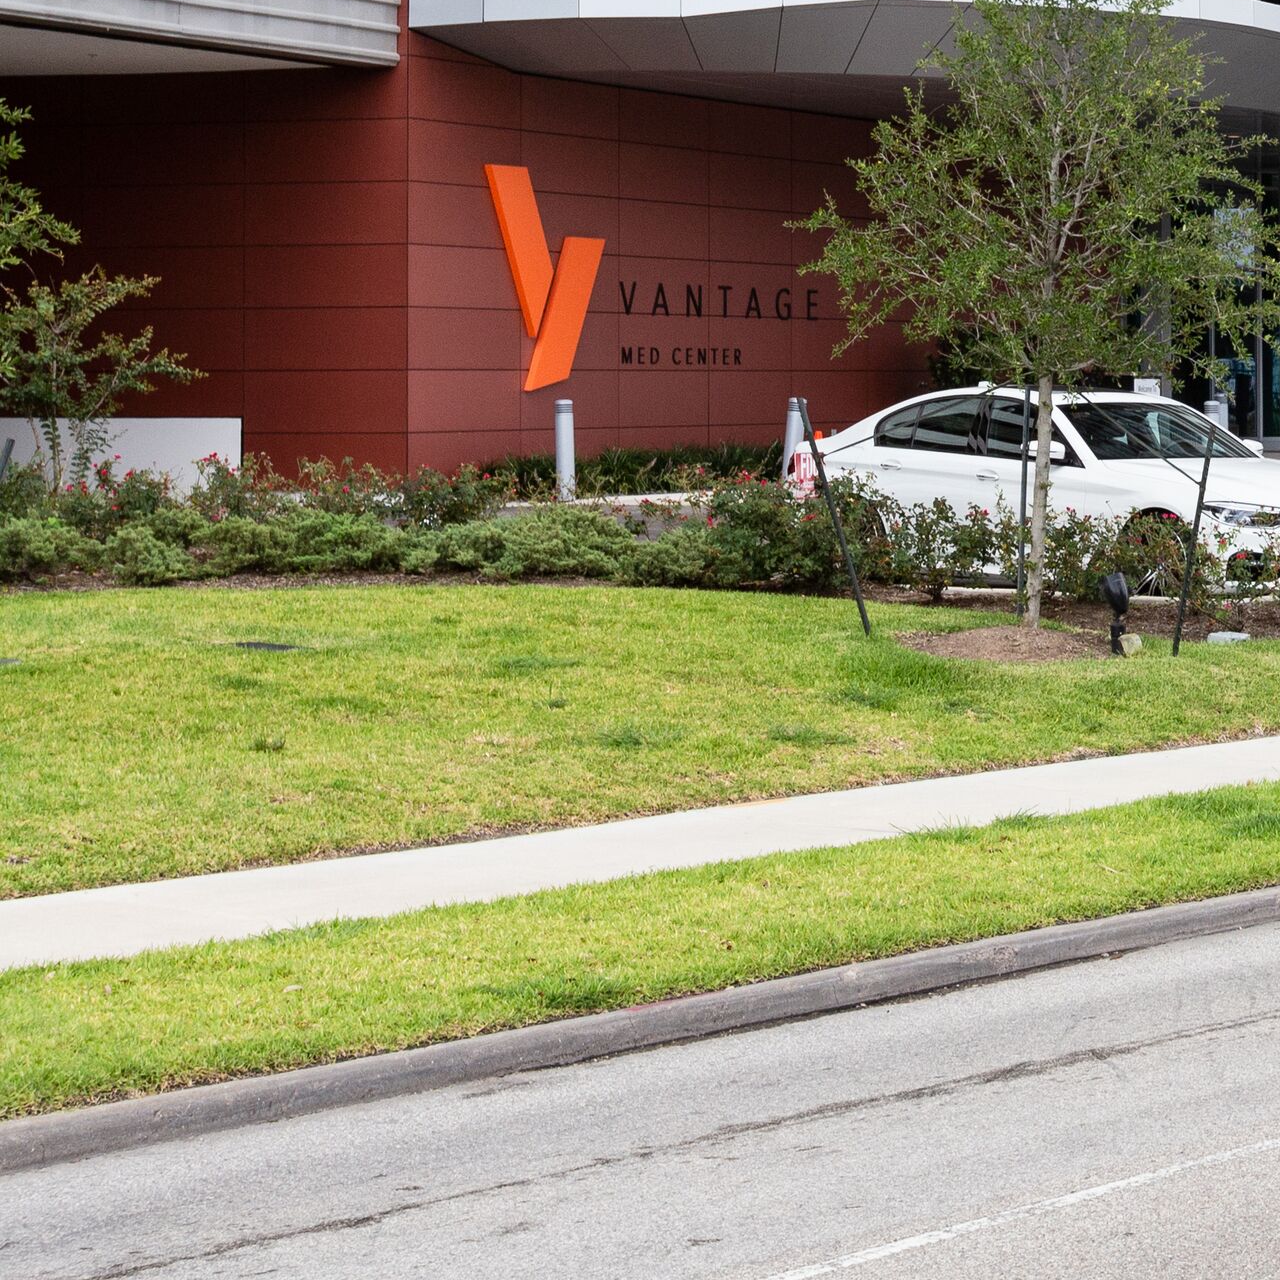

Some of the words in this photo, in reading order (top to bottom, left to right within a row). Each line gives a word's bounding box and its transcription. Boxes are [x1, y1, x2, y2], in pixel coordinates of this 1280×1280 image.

[619, 280, 820, 321] VANTAGE
[621, 346, 660, 365] MED
[672, 347, 743, 366] CENTER
